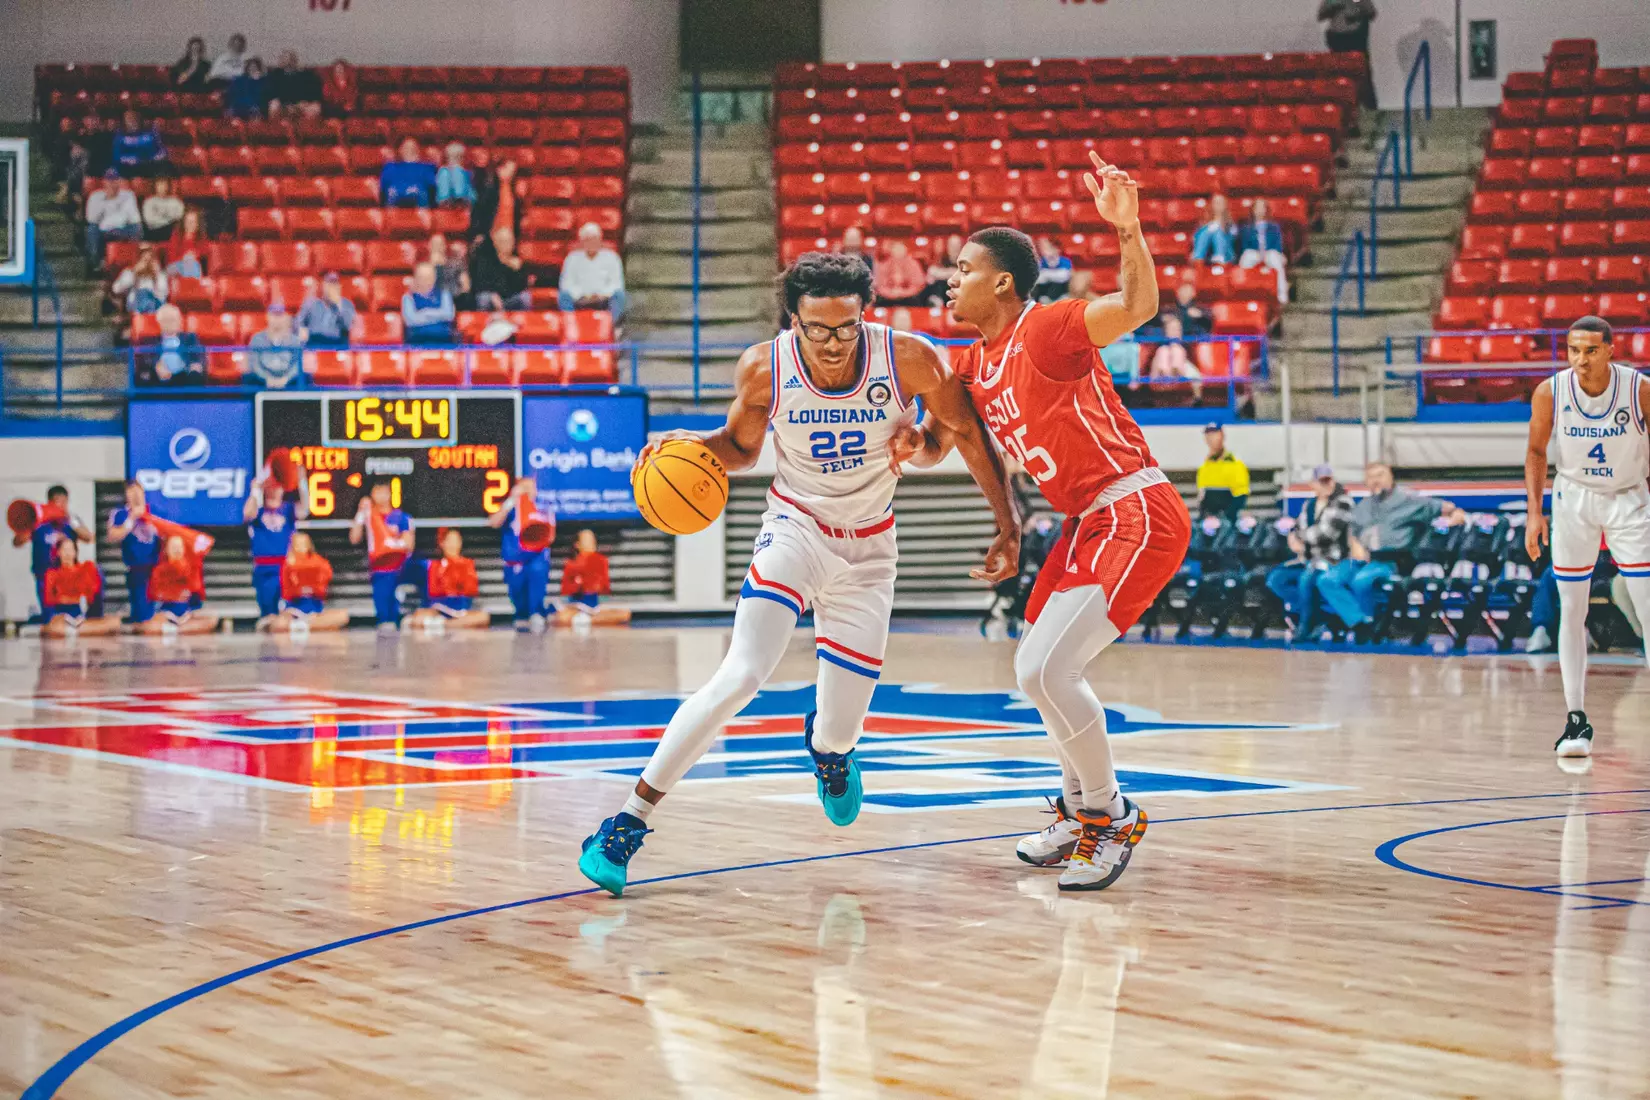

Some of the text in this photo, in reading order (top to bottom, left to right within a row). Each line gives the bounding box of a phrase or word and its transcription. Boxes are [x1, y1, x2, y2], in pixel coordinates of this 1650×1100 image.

[345, 397, 449, 441] 15:44
[788, 409, 887, 424] LOUISIANA
[1564, 425, 1627, 438] LOUISIANA
[809, 430, 867, 459] 22
[1588, 443, 1606, 464] 4
[529, 448, 588, 473] Origin
[820, 457, 864, 474] TECH
[1582, 467, 1613, 477] TECH
[136, 468, 246, 498] PEPSI
[390, 477, 401, 508] 1
[483, 469, 509, 514] 2
